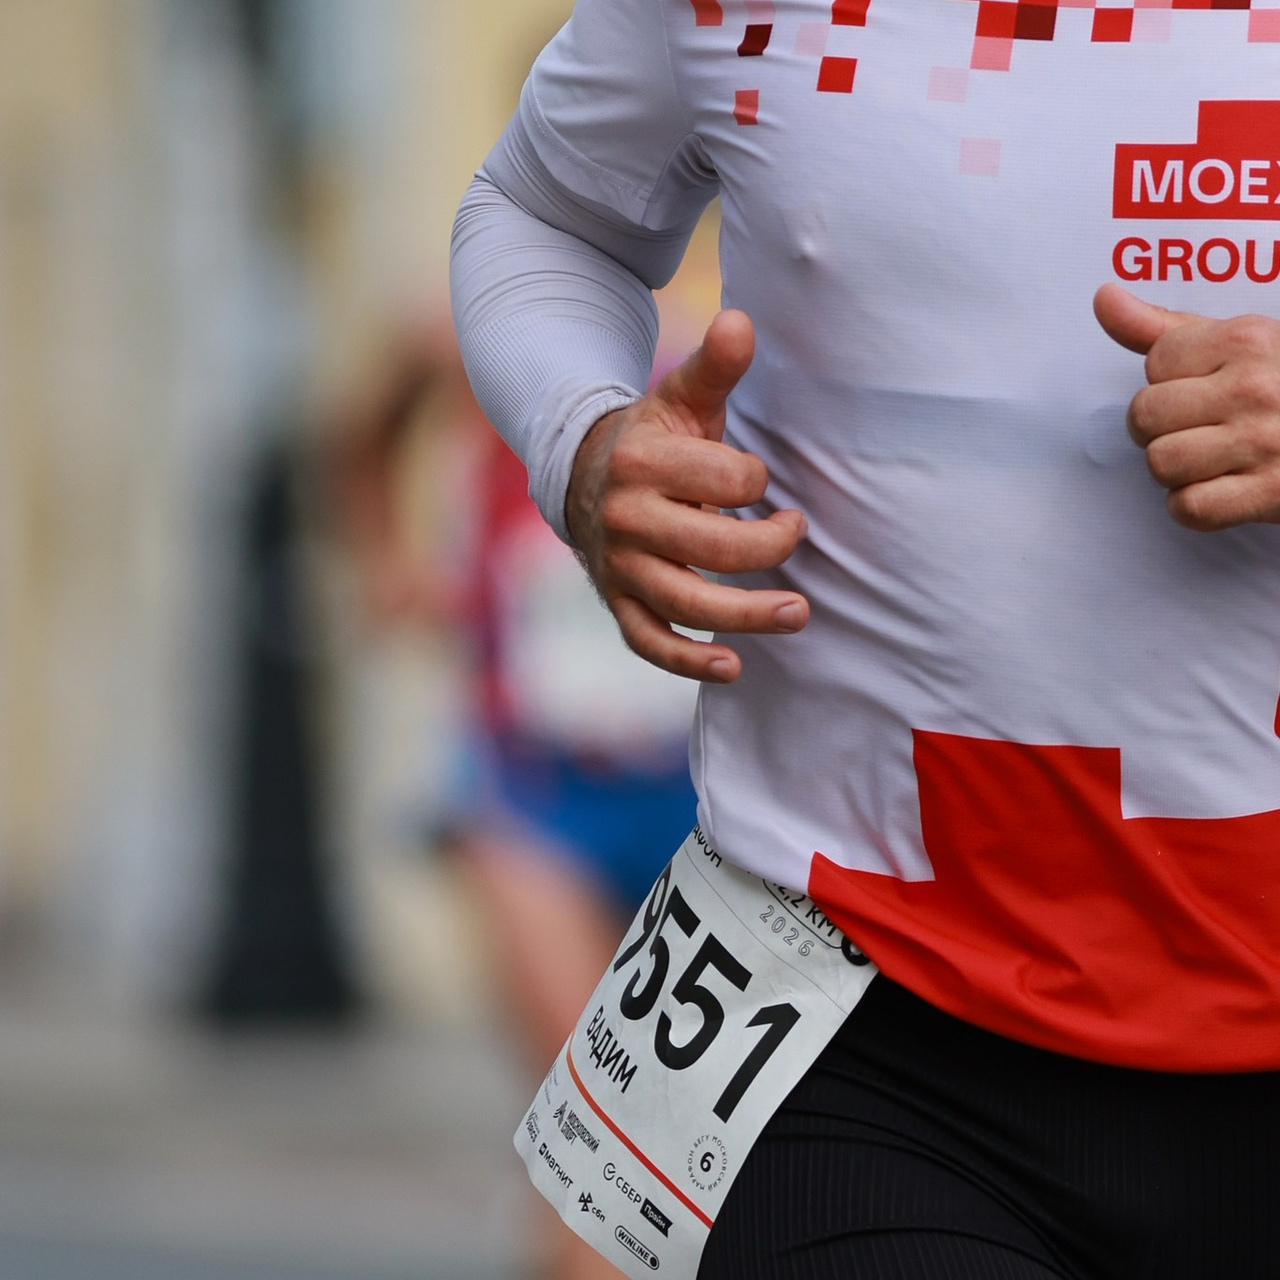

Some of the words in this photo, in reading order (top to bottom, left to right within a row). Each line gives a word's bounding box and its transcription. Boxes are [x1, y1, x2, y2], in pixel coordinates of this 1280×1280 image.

[759, 904, 815, 957] 2026
[586, 1005, 638, 1094] ВАДИМ
[700, 1151, 716, 1173] 6
[615, 1176, 642, 1204] СБЕР
[617, 1229, 650, 1261] WINLINE
